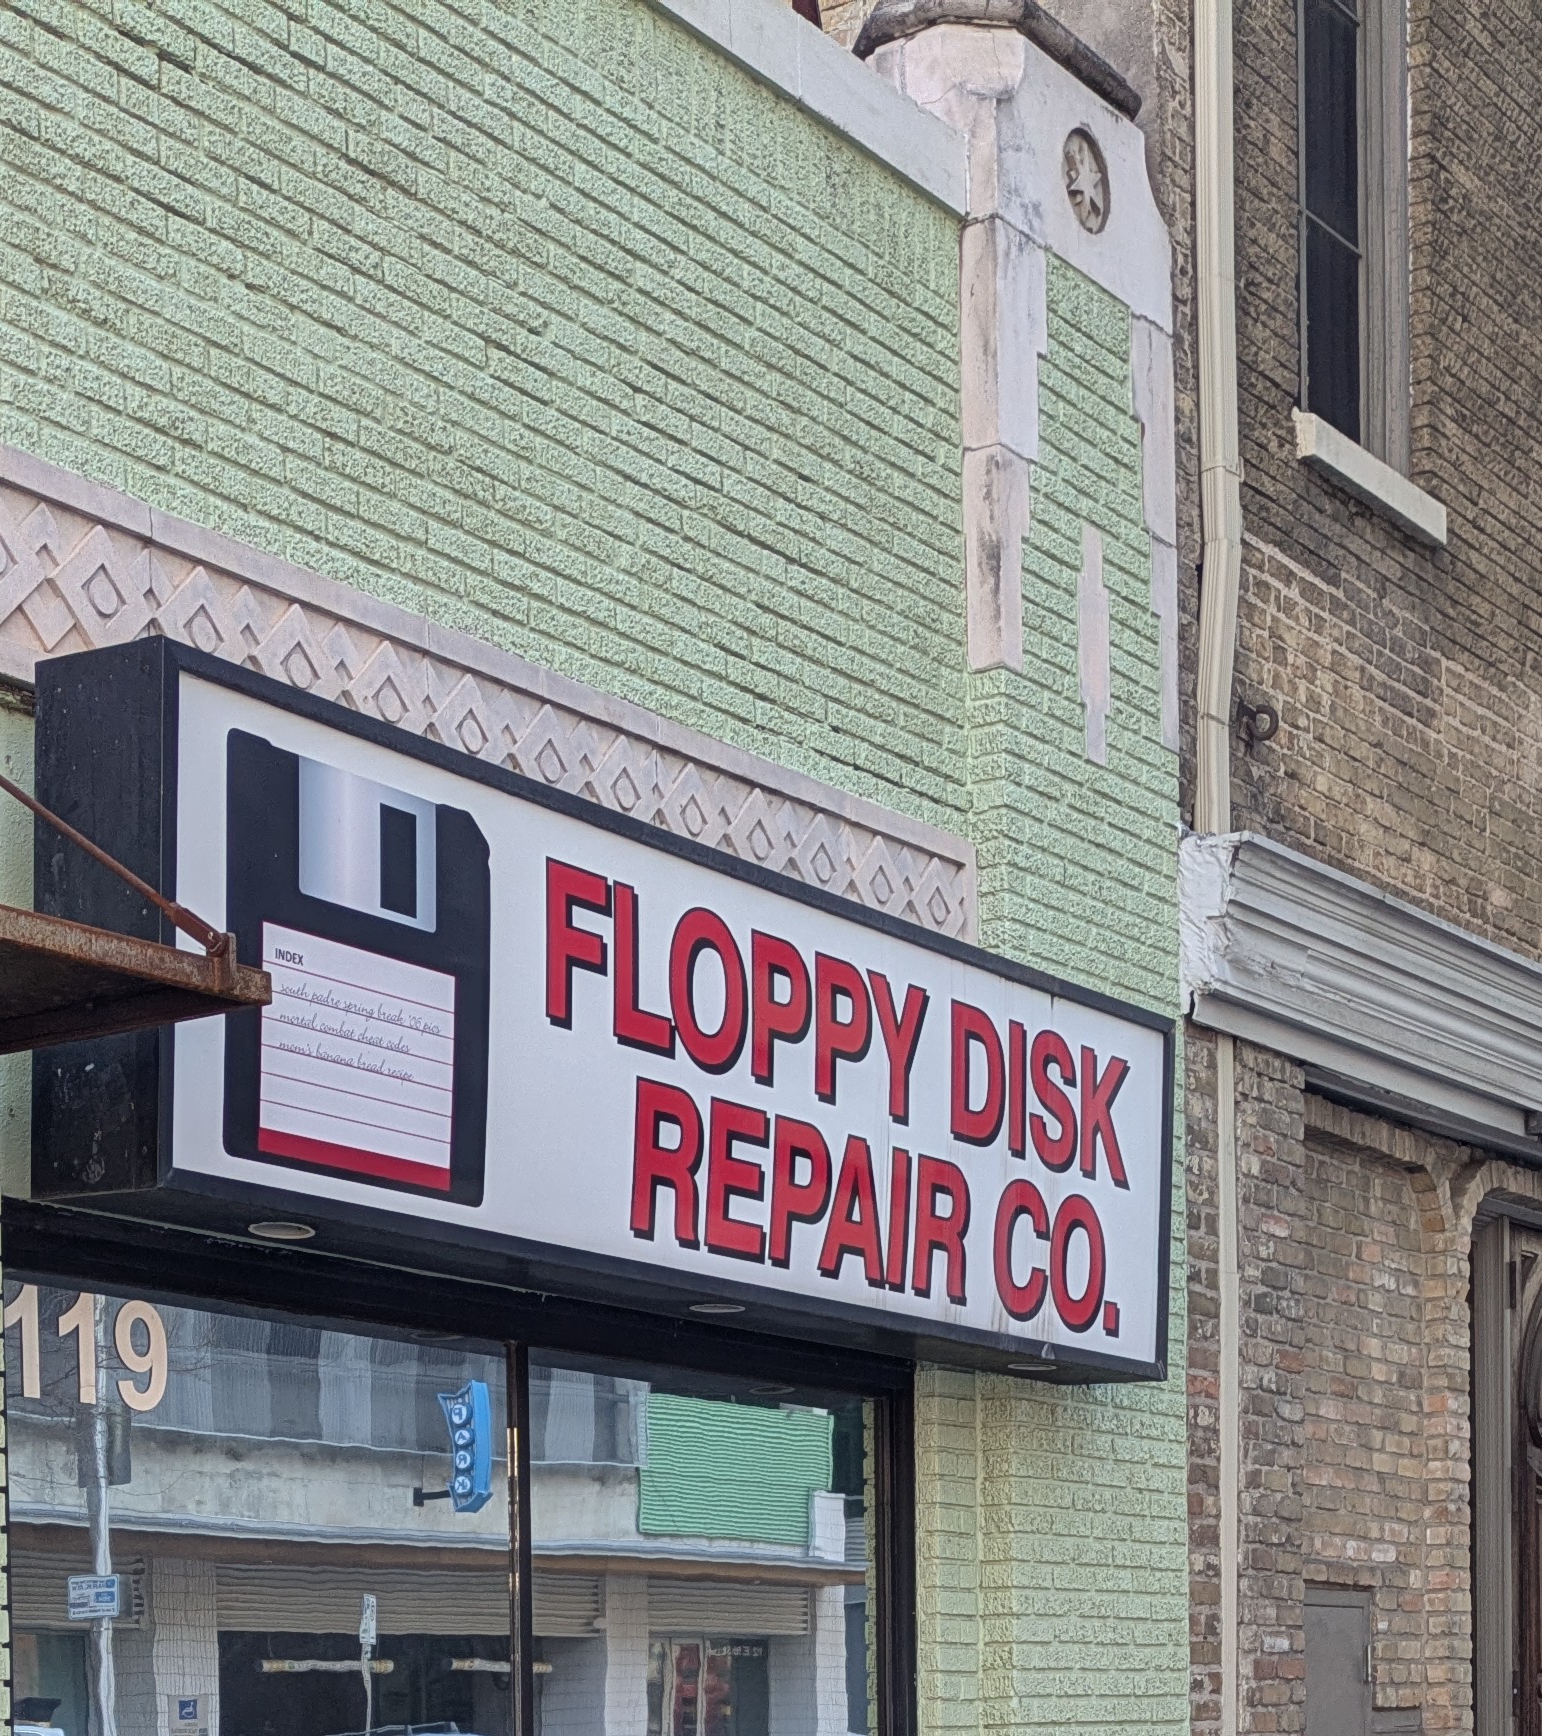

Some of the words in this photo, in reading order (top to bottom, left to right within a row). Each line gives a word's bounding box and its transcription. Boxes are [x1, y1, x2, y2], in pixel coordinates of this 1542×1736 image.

[274, 947, 304, 966] INDEX
[279, 1012, 318, 1029] mortal
[319, 1020, 356, 1038] combat
[357, 1026, 385, 1046] cheat
[386, 1036, 411, 1054] codes
[280, 982, 310, 998] south
[310, 989, 341, 1007] padre
[342, 1000, 375, 1021] spring
[377, 1003, 406, 1025] break
[421, 1021, 442, 1036] pics
[544, 857, 930, 1124] FLOPPY
[950, 998, 1130, 1188] DISK
[279, 1040, 313, 1056] mom's
[314, 1042, 355, 1066] banana
[357, 1052, 387, 1075] bread
[387, 1067, 414, 1086] recipe
[631, 1076, 969, 1303] REPAIR
[992, 1177, 1120, 1337] CO.
[4, 1284, 168, 1411] 119
